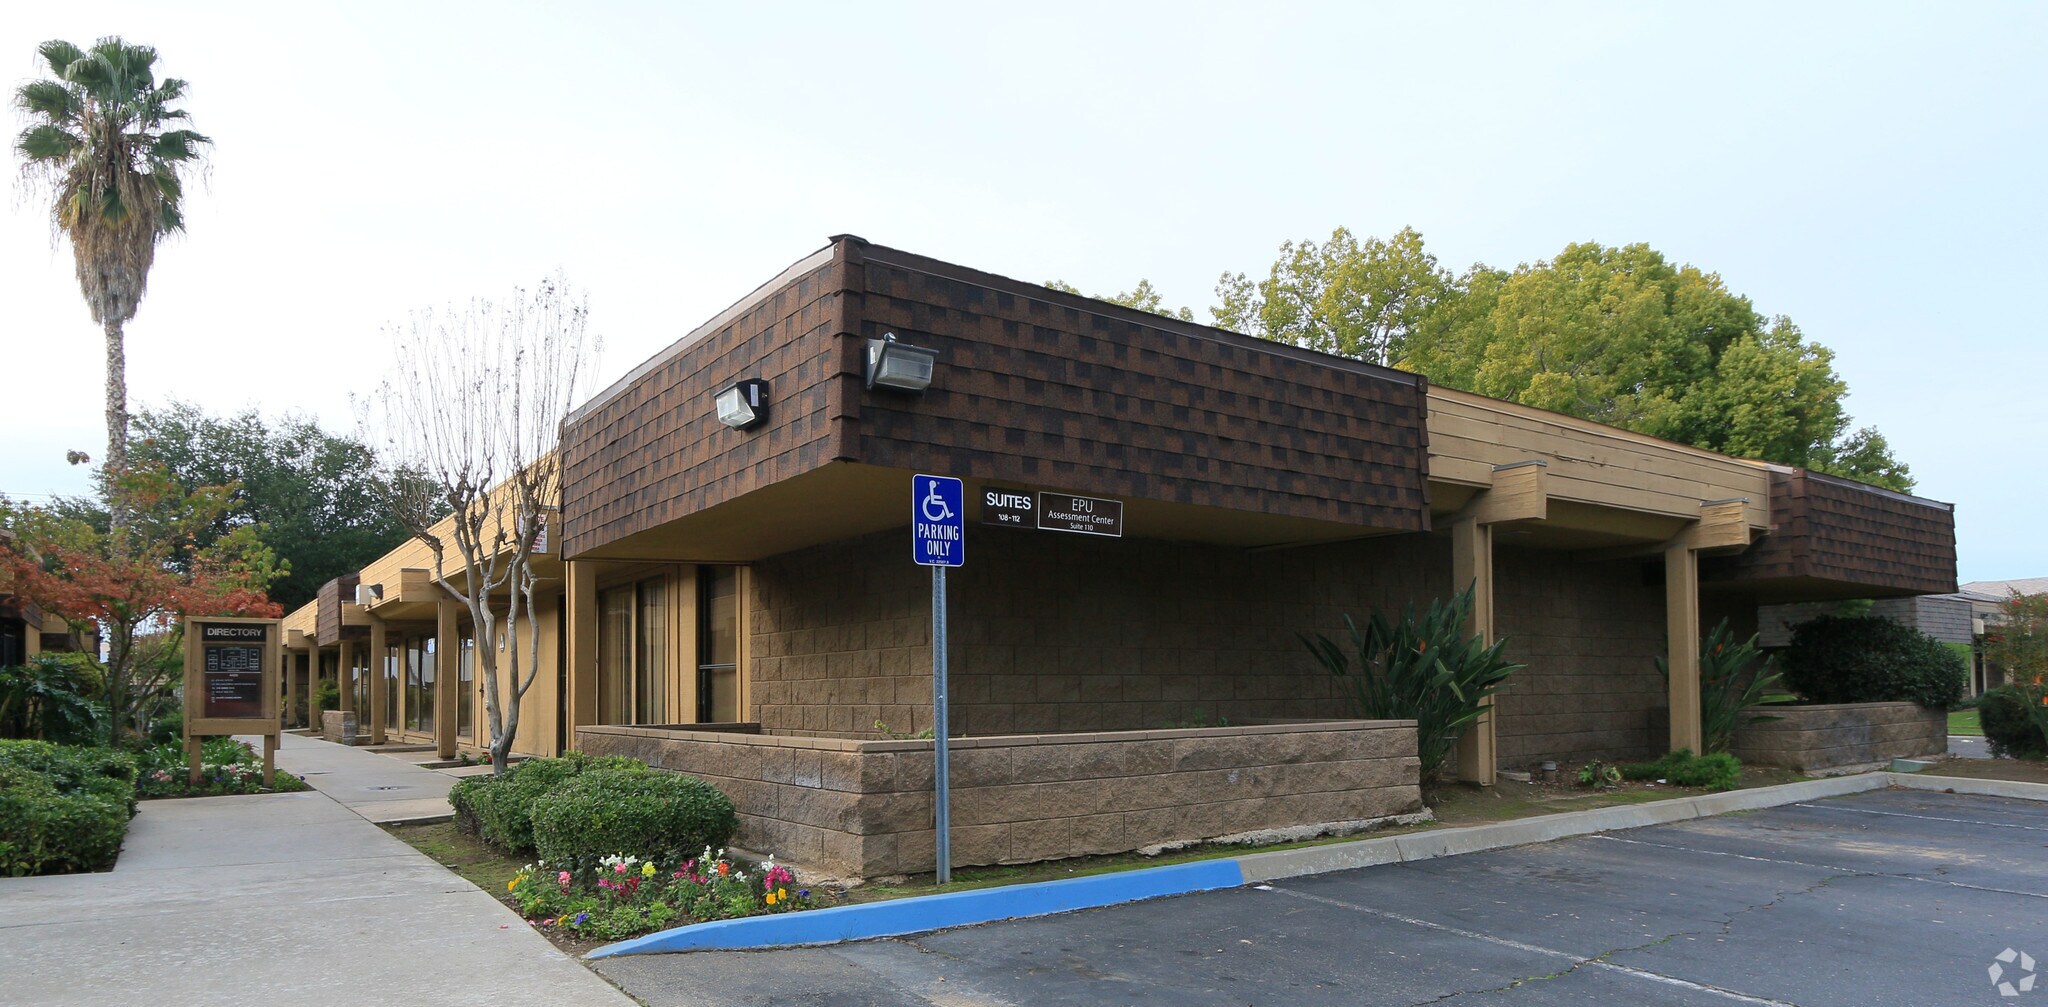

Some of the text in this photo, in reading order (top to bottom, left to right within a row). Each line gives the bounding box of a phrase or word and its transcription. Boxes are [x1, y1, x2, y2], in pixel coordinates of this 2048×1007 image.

[986, 492, 1032, 510] SUITES
[1072, 498, 1093, 513] EPU
[1048, 510, 1114, 525] Assessment Center
[918, 522, 959, 541] PARKING
[1070, 522, 1083, 531] Suite
[927, 540, 951, 556] ONLY
[207, 627, 262, 637] DIRECTORY
